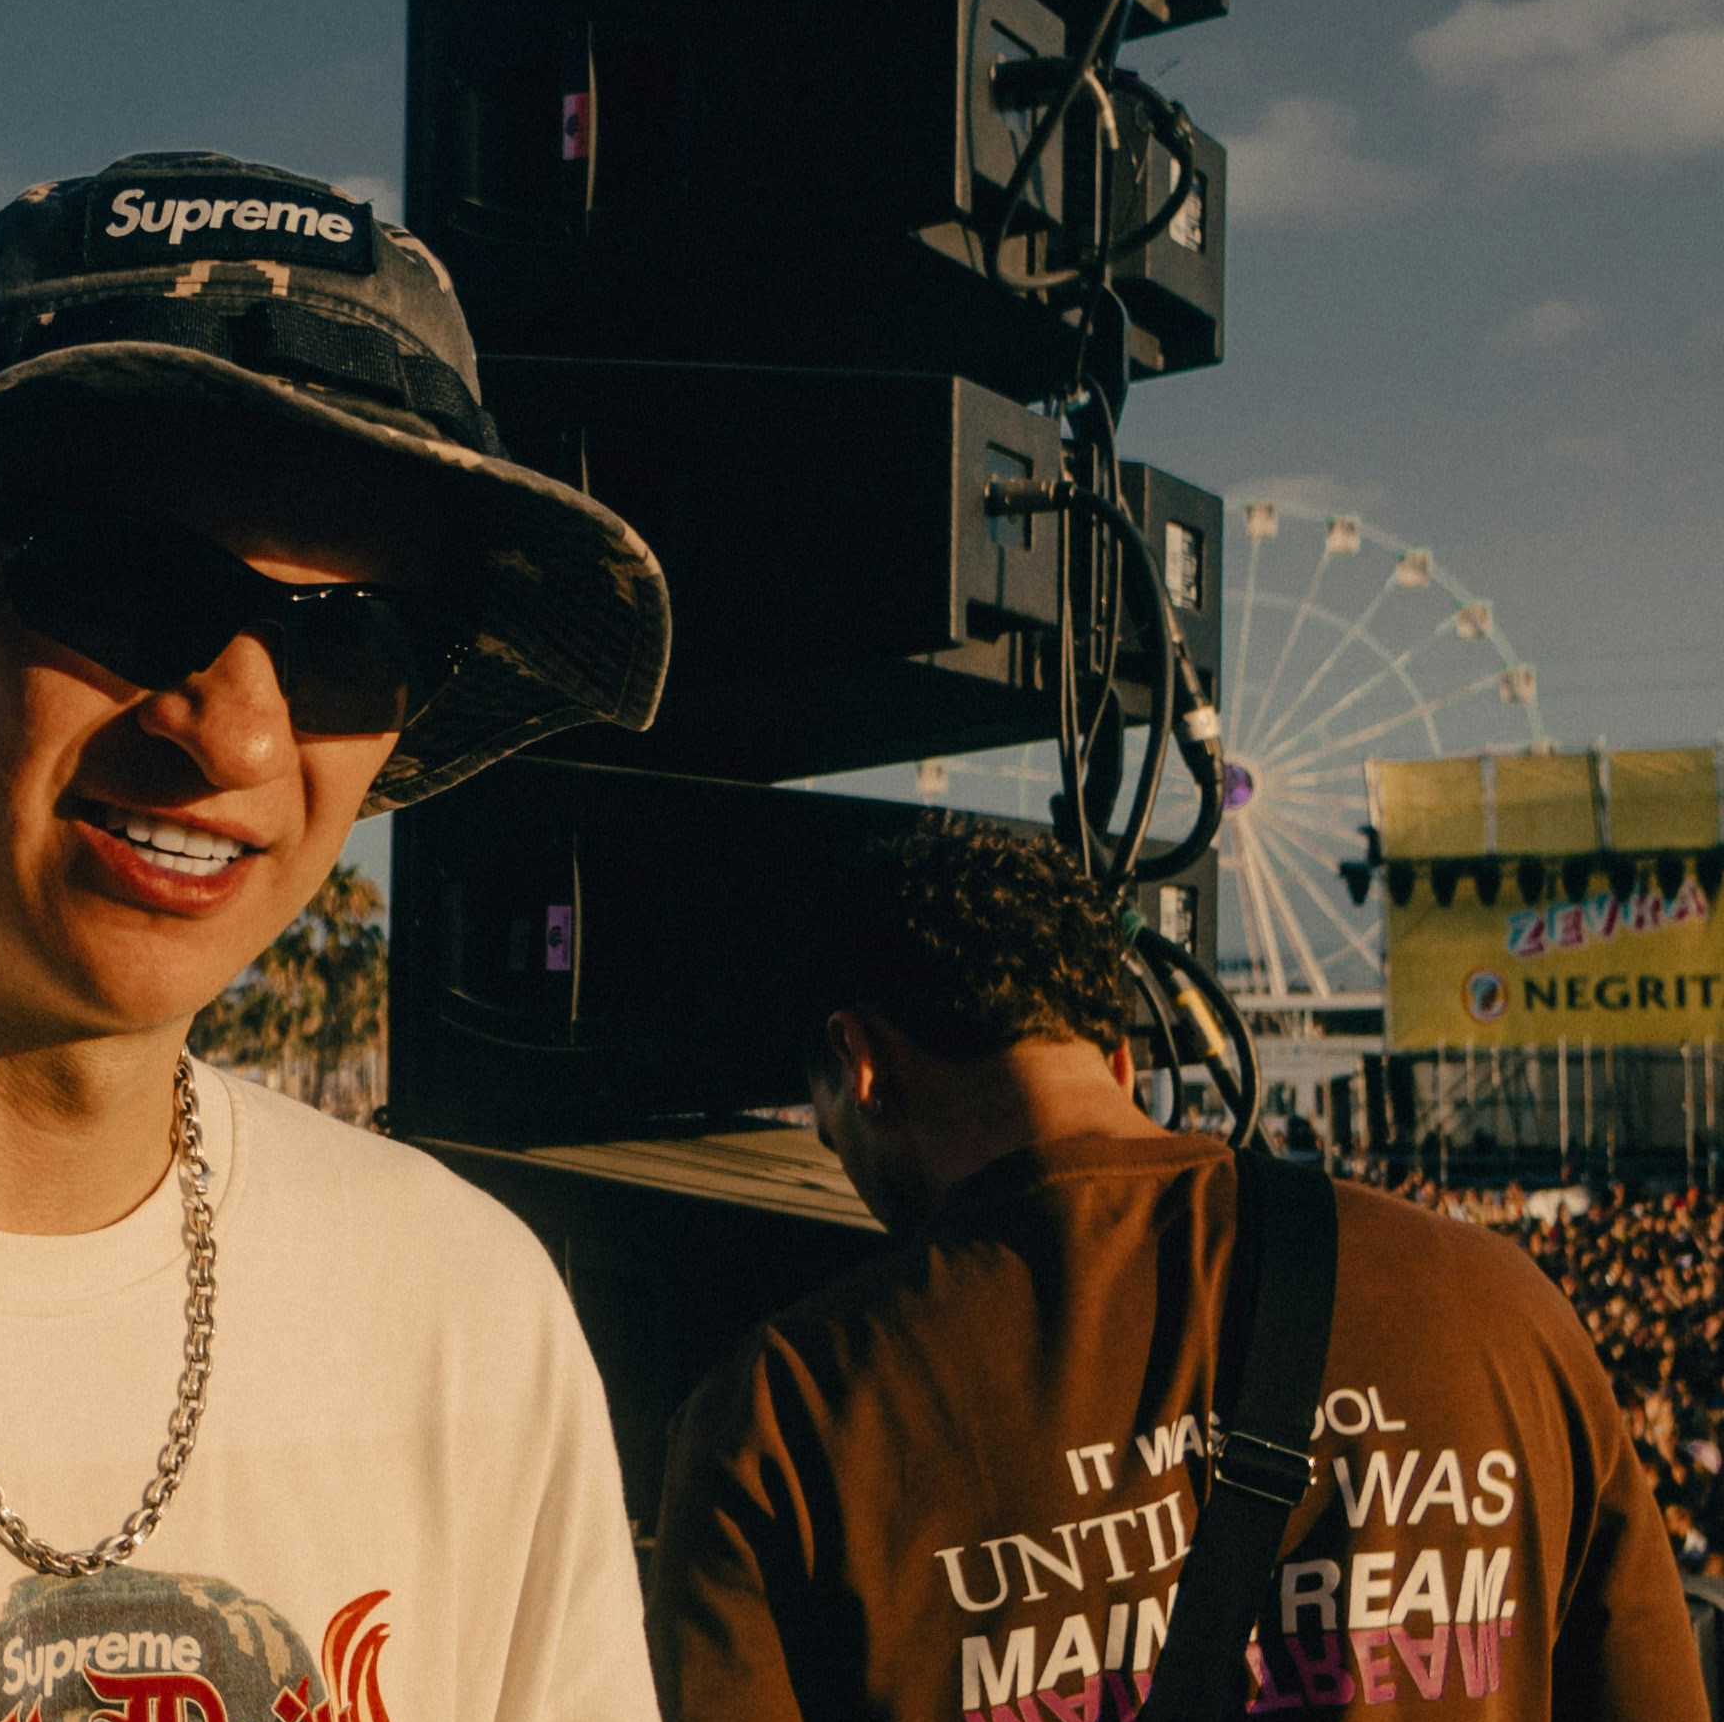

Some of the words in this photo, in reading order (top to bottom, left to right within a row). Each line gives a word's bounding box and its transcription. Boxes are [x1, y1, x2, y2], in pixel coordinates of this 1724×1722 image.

[105, 188, 355, 245] Supreme
[1523, 972, 1724, 1011] NEGRIT
[1065, 1441, 1117, 1495] IT
[933, 1490, 1193, 1613] UNTIL
[1333, 1448, 1518, 1529] WAS
[2, 1630, 202, 1697] Supreme
